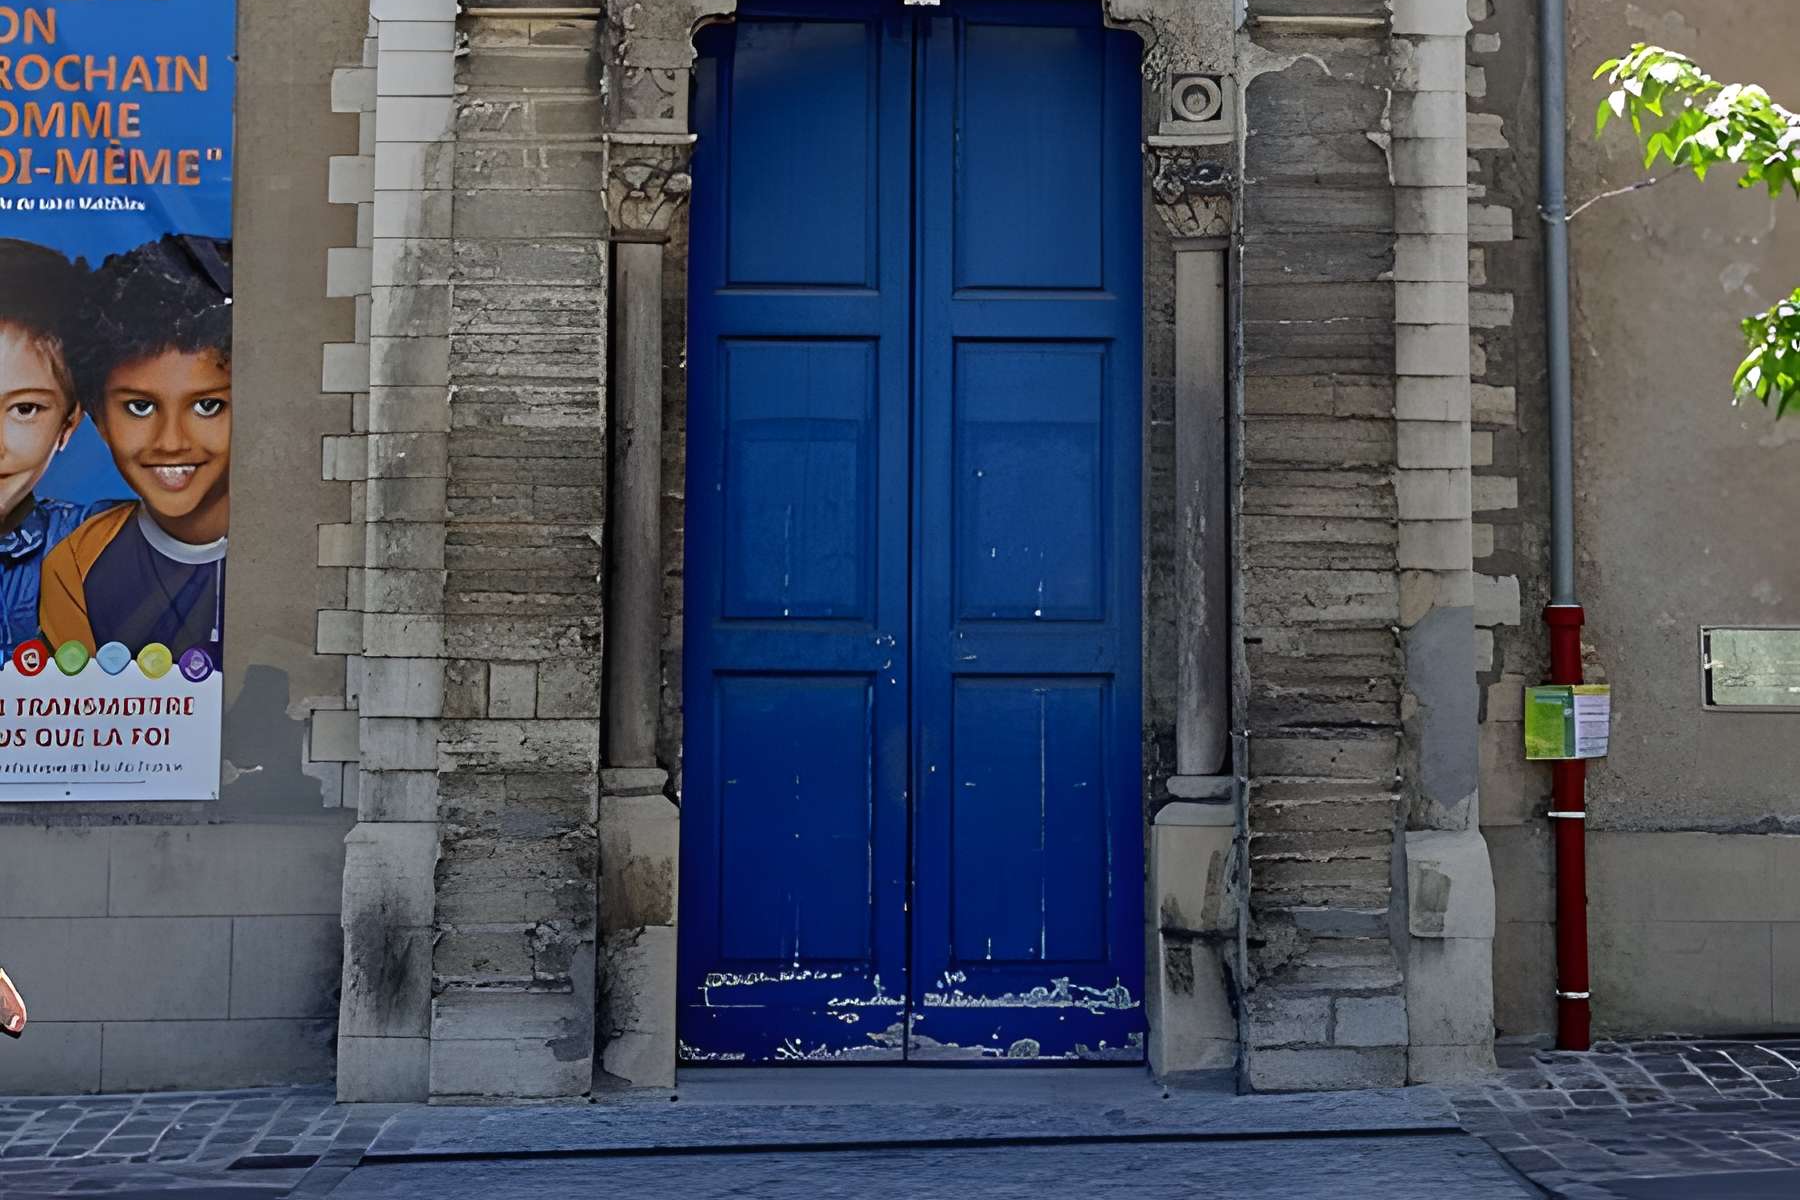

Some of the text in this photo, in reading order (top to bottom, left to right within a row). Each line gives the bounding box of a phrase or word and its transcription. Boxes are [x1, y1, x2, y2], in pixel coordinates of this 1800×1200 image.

[35, 728, 84, 747] QUE
[93, 728, 123, 747] LA
[131, 727, 170, 746] FOI
